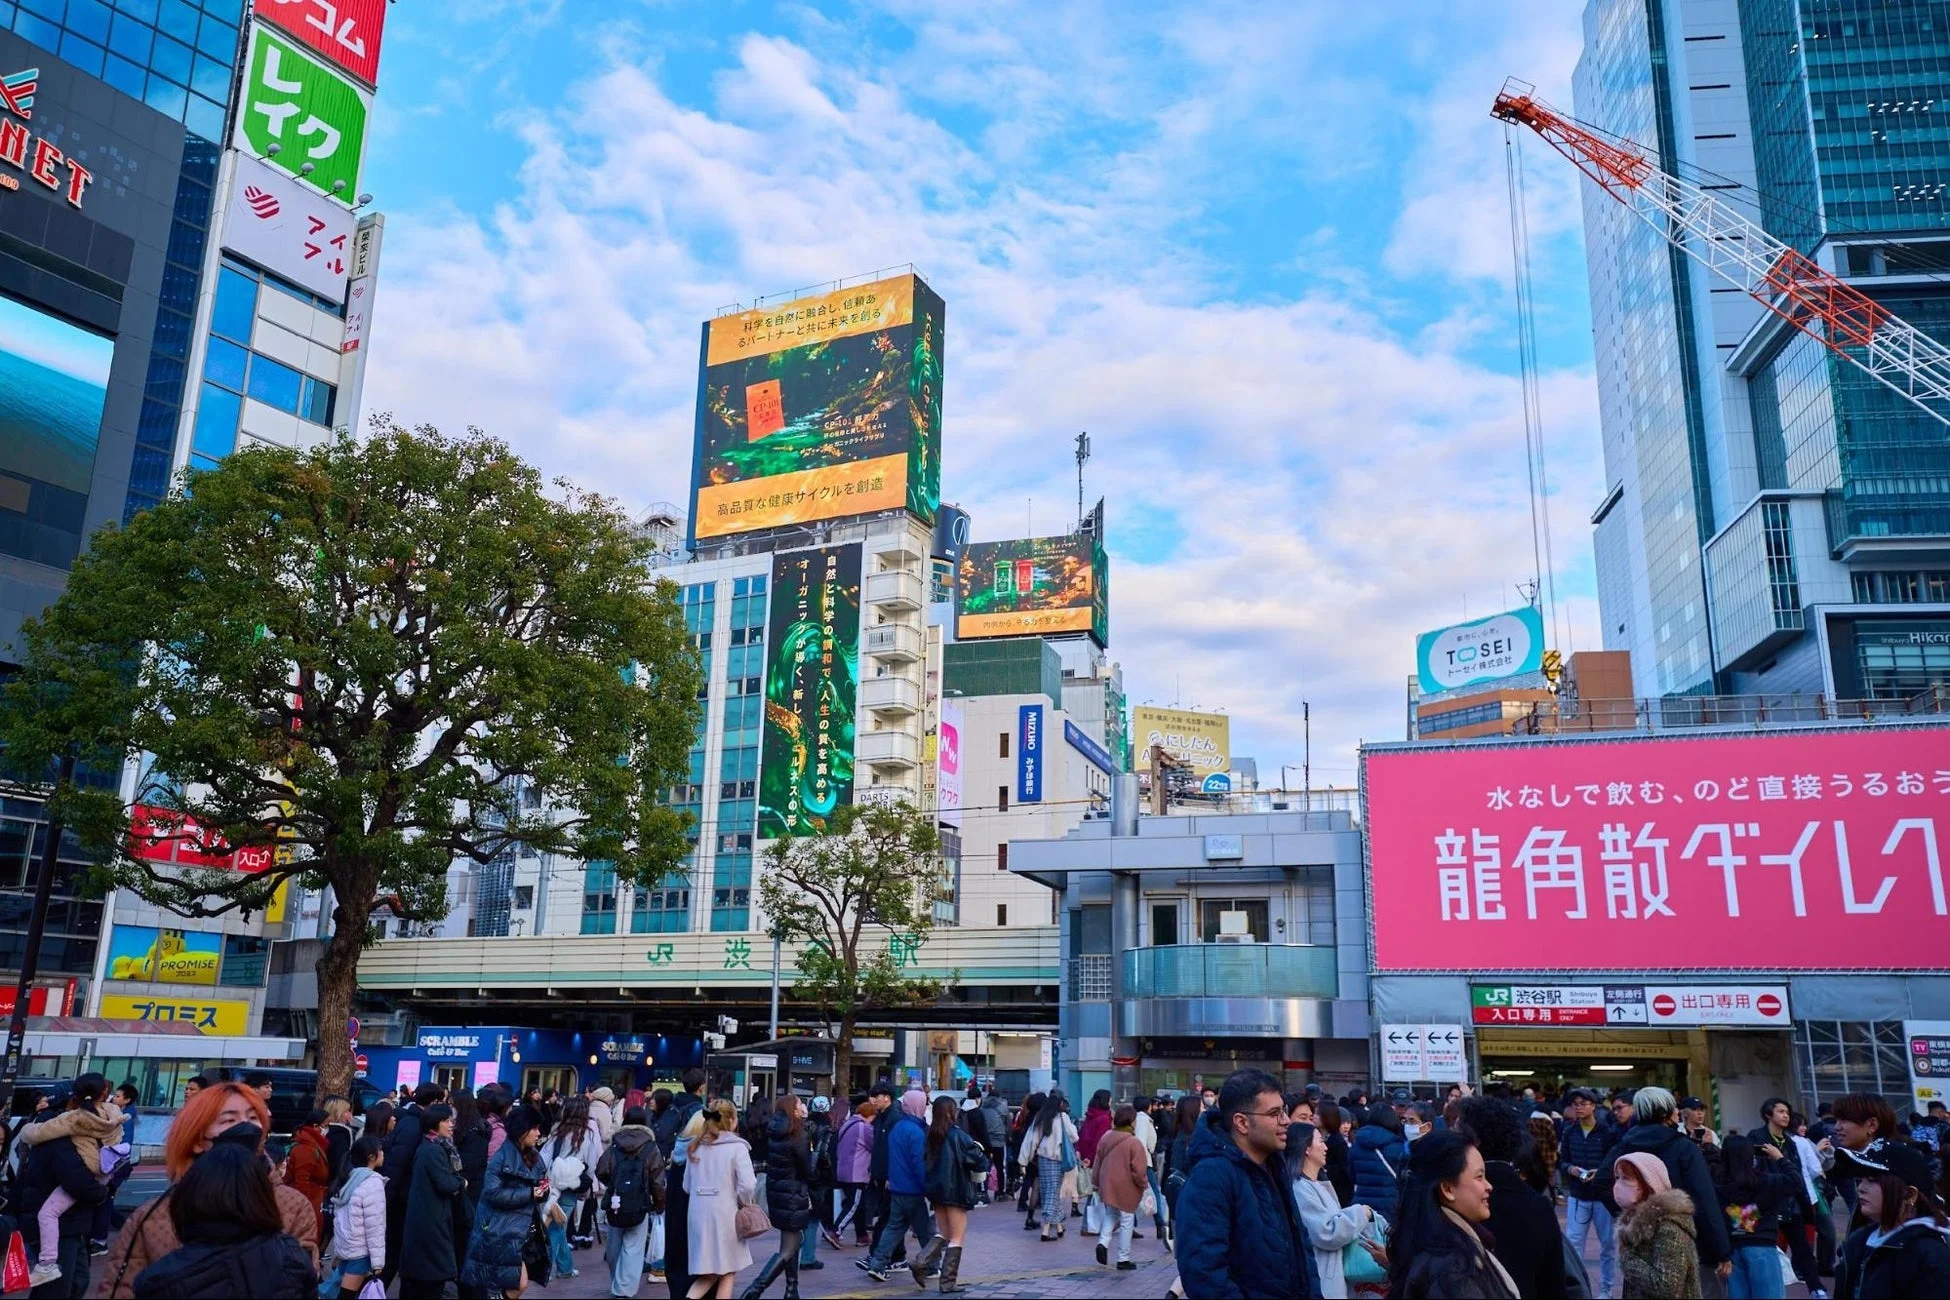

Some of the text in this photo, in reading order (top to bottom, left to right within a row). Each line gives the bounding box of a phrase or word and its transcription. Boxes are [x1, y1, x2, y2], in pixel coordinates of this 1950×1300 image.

[274, 0, 366, 59] コム
[738, 308, 881, 348] るパートナーと共に未来を創る
[717, 477, 884, 516] 高品質な健康サイクルを創造
[1447, 656, 1512, 678] トーセイ株式会社
[1027, 712, 1037, 750] MIZUHO
[860, 792, 889, 803] DARTS
[239, 851, 260, 867] 入口
[648, 944, 673, 961] JR
[160, 959, 215, 971] PROMISE
[1486, 988, 1510, 1001] JR
[1516, 990, 1563, 1005] 渋谷駅
[1569, 991, 1598, 999] Shibuya
[1682, 994, 1750, 1009] 出口専用
[1492, 1008, 1552, 1022] 入口専用
[419, 1035, 480, 1047] SCRAMBLE
[454, 1048, 470, 1056] Bar
